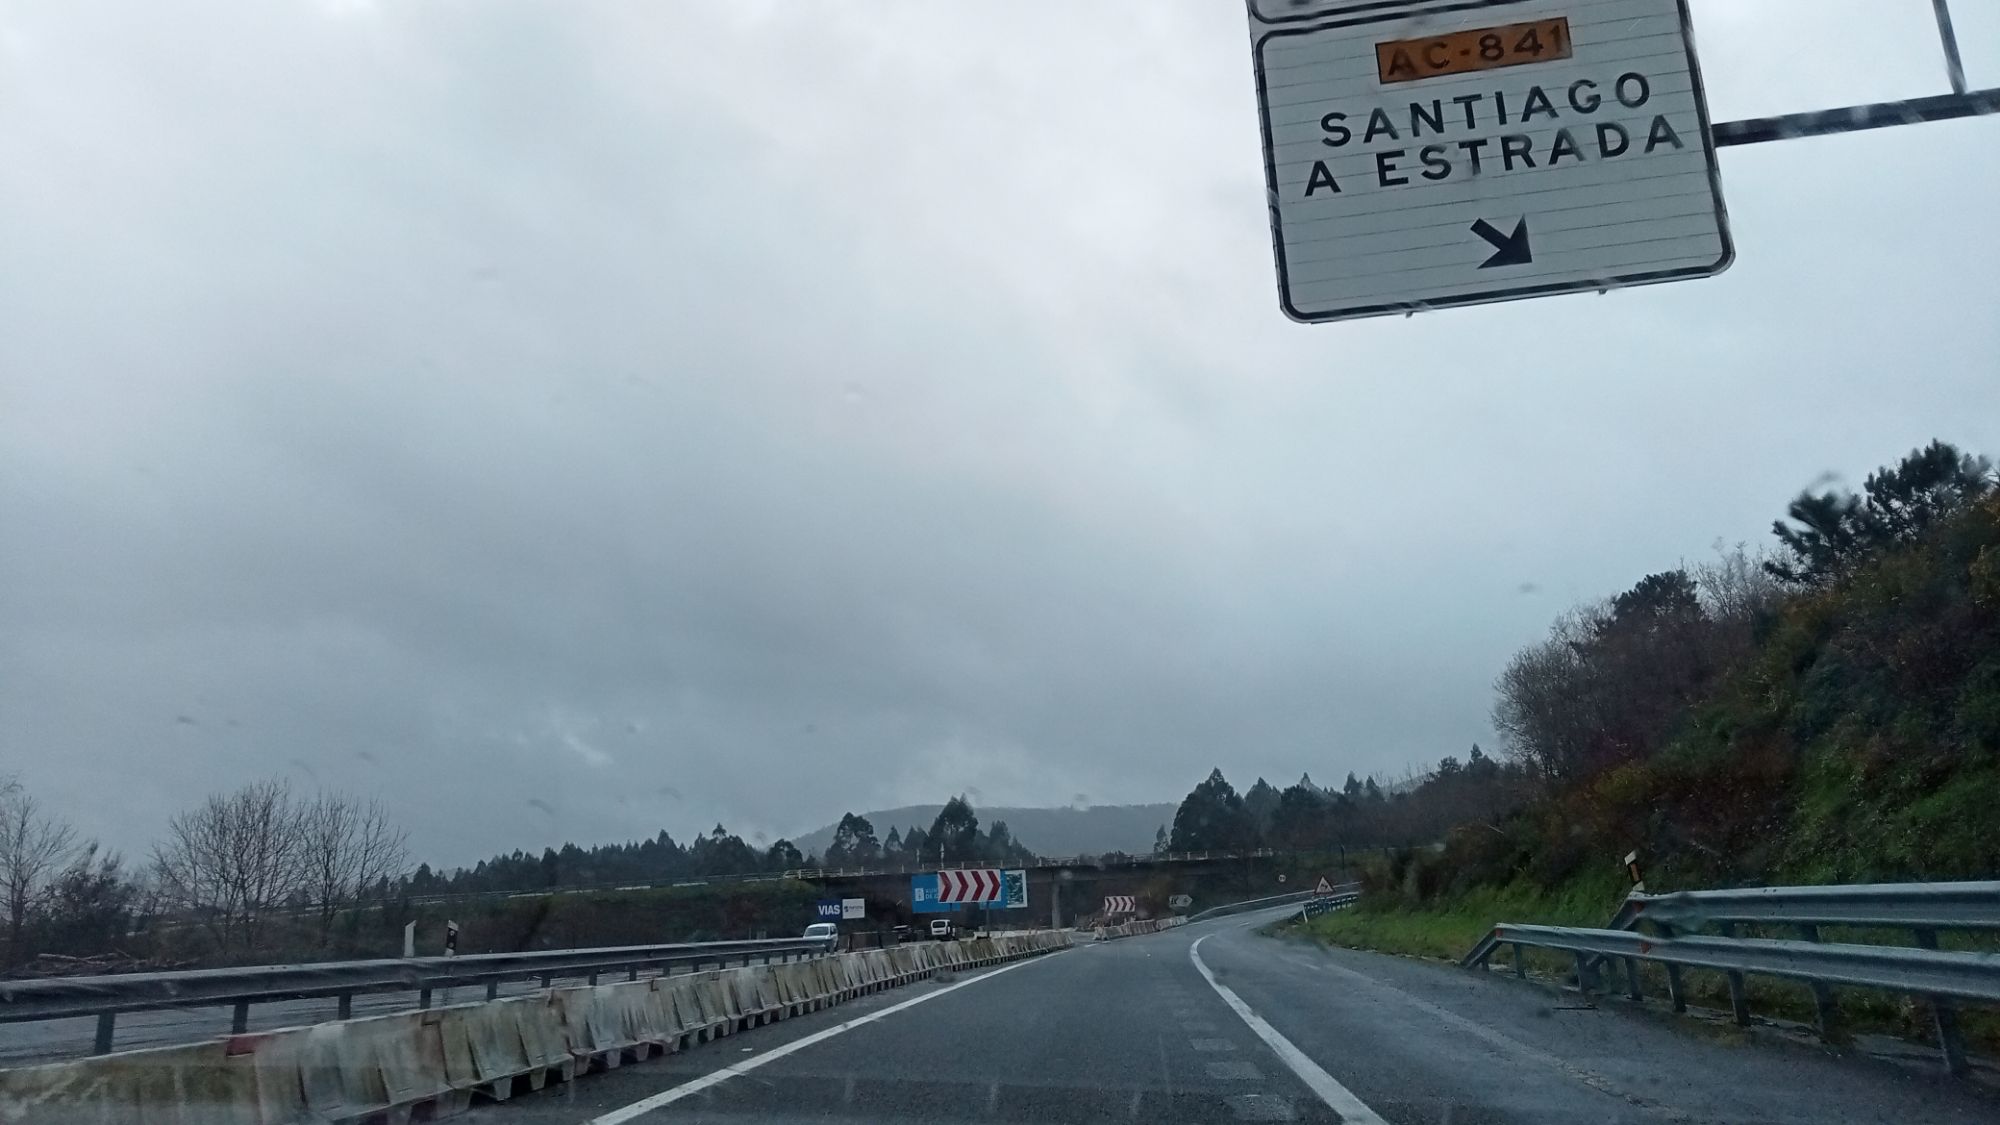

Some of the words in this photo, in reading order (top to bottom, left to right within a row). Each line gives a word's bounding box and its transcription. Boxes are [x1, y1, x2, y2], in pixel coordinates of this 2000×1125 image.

[1387, 24, 1563, 77] AC-841
[1321, 73, 1650, 147] SANTIAGO
[1304, 160, 1342, 197] A
[1376, 114, 1684, 187] ESTRADA
[818, 904, 841, 915] VIAS
